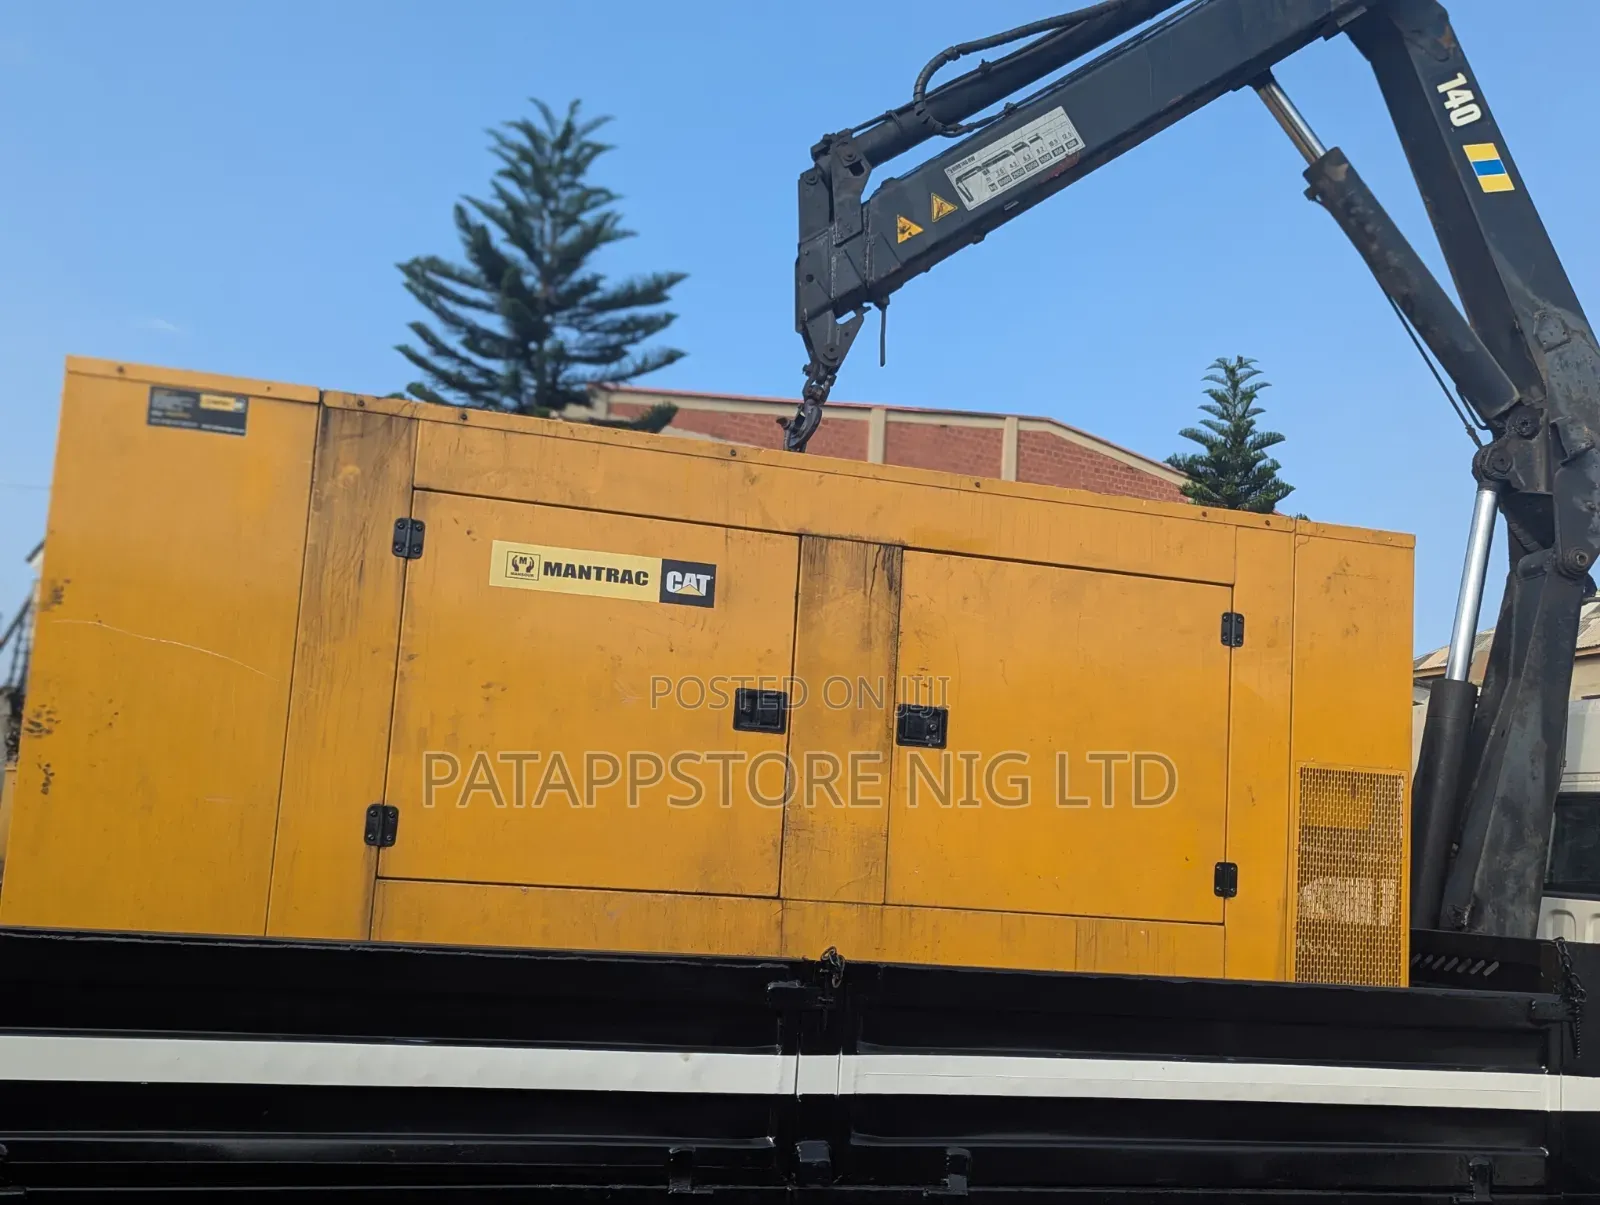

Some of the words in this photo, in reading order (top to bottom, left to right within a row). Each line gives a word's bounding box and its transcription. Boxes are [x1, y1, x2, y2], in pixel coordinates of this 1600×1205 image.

[1437, 72, 1481, 127] 140
[519, 556, 528, 564] M
[543, 561, 649, 586] MANTRAC
[666, 571, 711, 596] CAT
